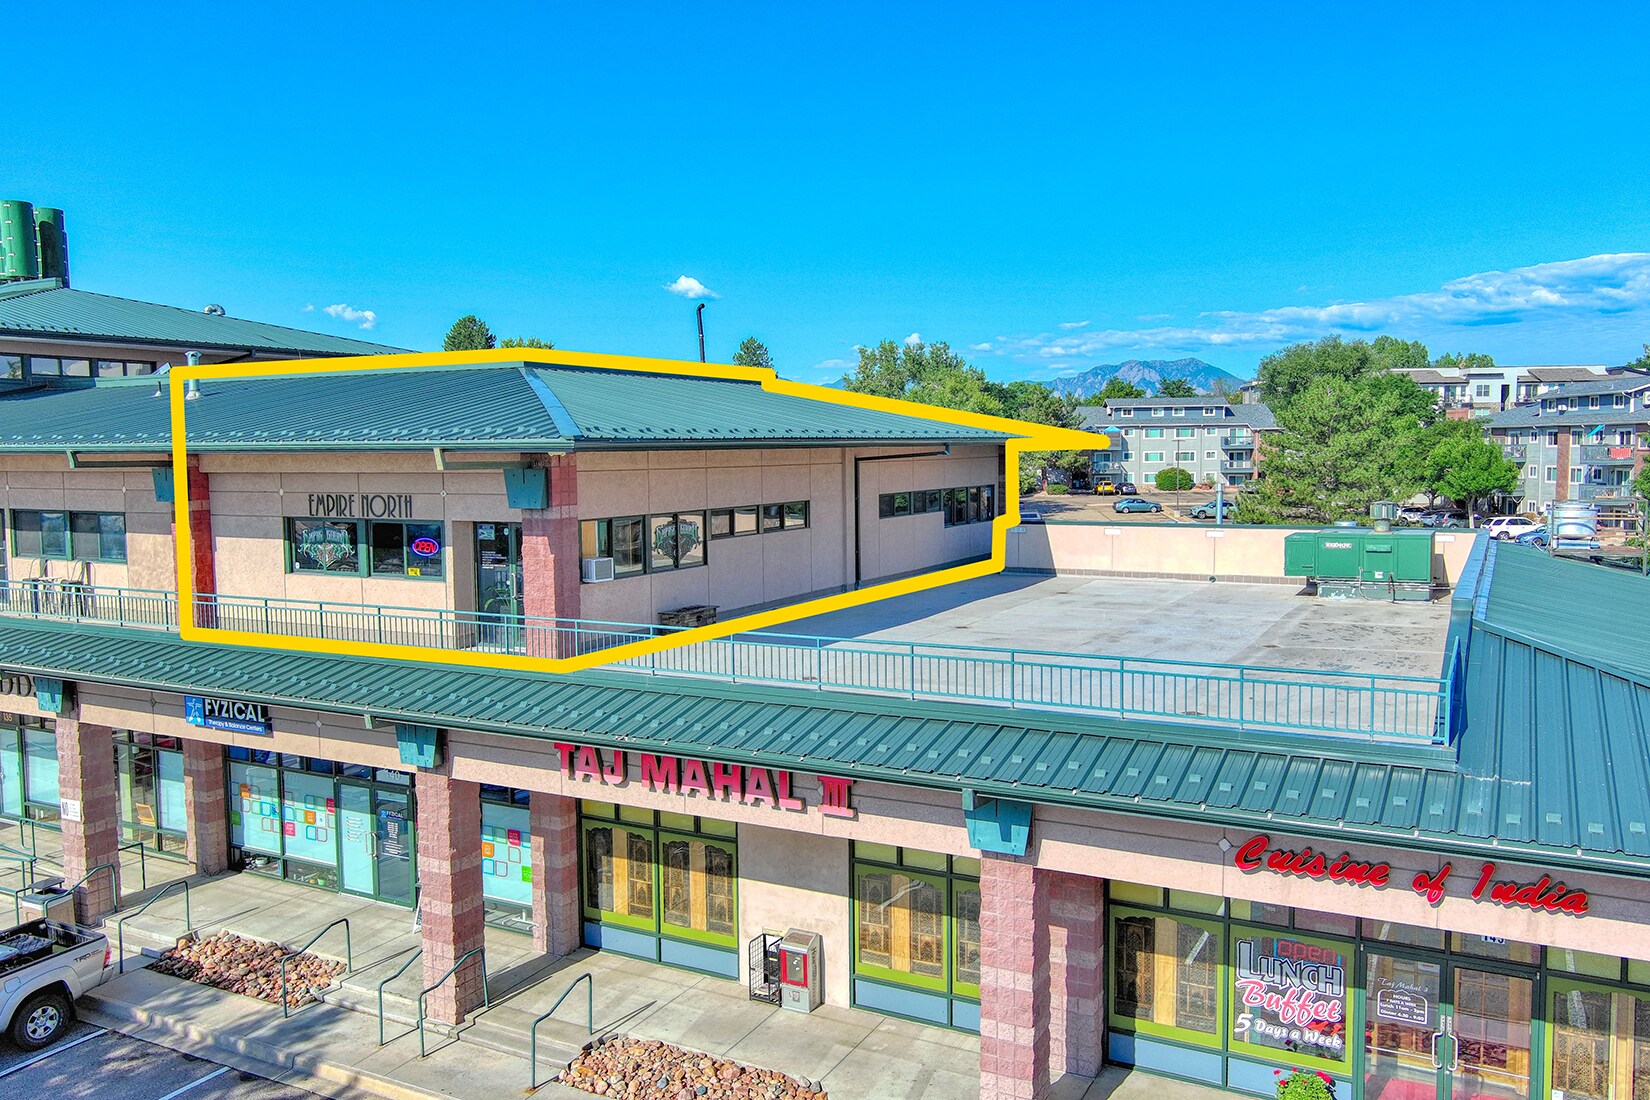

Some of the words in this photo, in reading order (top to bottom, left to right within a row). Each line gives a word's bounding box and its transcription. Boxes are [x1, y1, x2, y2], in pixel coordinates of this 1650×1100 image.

[308, 494, 355, 517] EMPIRE
[361, 494, 413, 518] NORTH
[414, 541, 437, 554] OPEN
[0, 675, 37, 698] DD
[2, 712, 13, 722] 135
[205, 698, 265, 723] FYZICAL
[208, 719, 225, 728] Therapy
[228, 721, 246, 730] Balance
[245, 724, 263, 732] Centers
[386, 771, 400, 780] 140
[554, 742, 625, 785] TAJ
[641, 753, 804, 810] MAHAL
[817, 775, 858, 818] III
[1234, 834, 1390, 887] Cuisine
[1412, 862, 1451, 904] of
[1471, 862, 1590, 915] India
[1237, 940, 1343, 997] LUNCH
[1377, 977, 1395, 988] Taj
[1395, 981, 1421, 991] Mahal
[1235, 979, 1342, 1028] Buffet
[1234, 1013, 1254, 1033] 5
[1254, 1018, 1289, 1039] Days
[1289, 1029, 1302, 1041] a
[1303, 1027, 1343, 1049] Week
